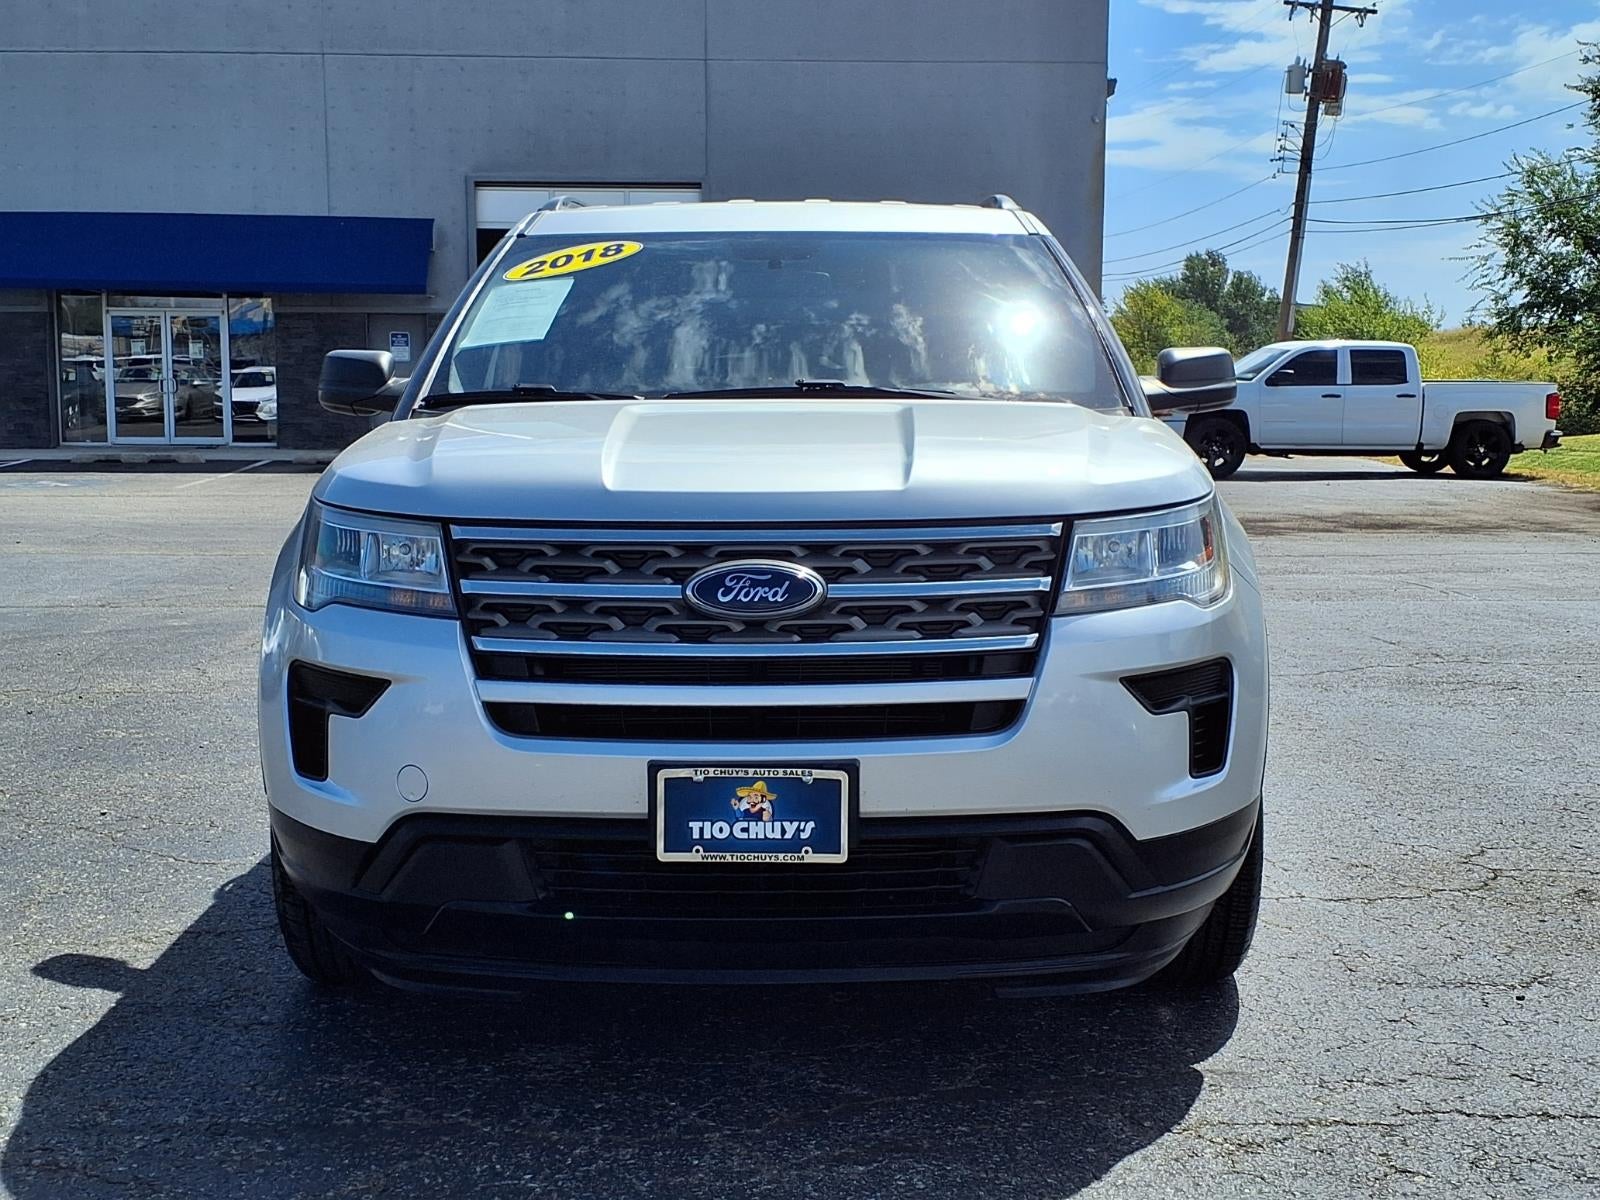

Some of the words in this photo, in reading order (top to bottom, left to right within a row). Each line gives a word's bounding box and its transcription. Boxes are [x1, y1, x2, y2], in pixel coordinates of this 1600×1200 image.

[520, 243, 625, 278] 2018
[717, 573, 791, 603] Ford
[752, 769, 780, 777] AUTO
[701, 853, 805, 862] WWW.TIOCHUYS.COM
